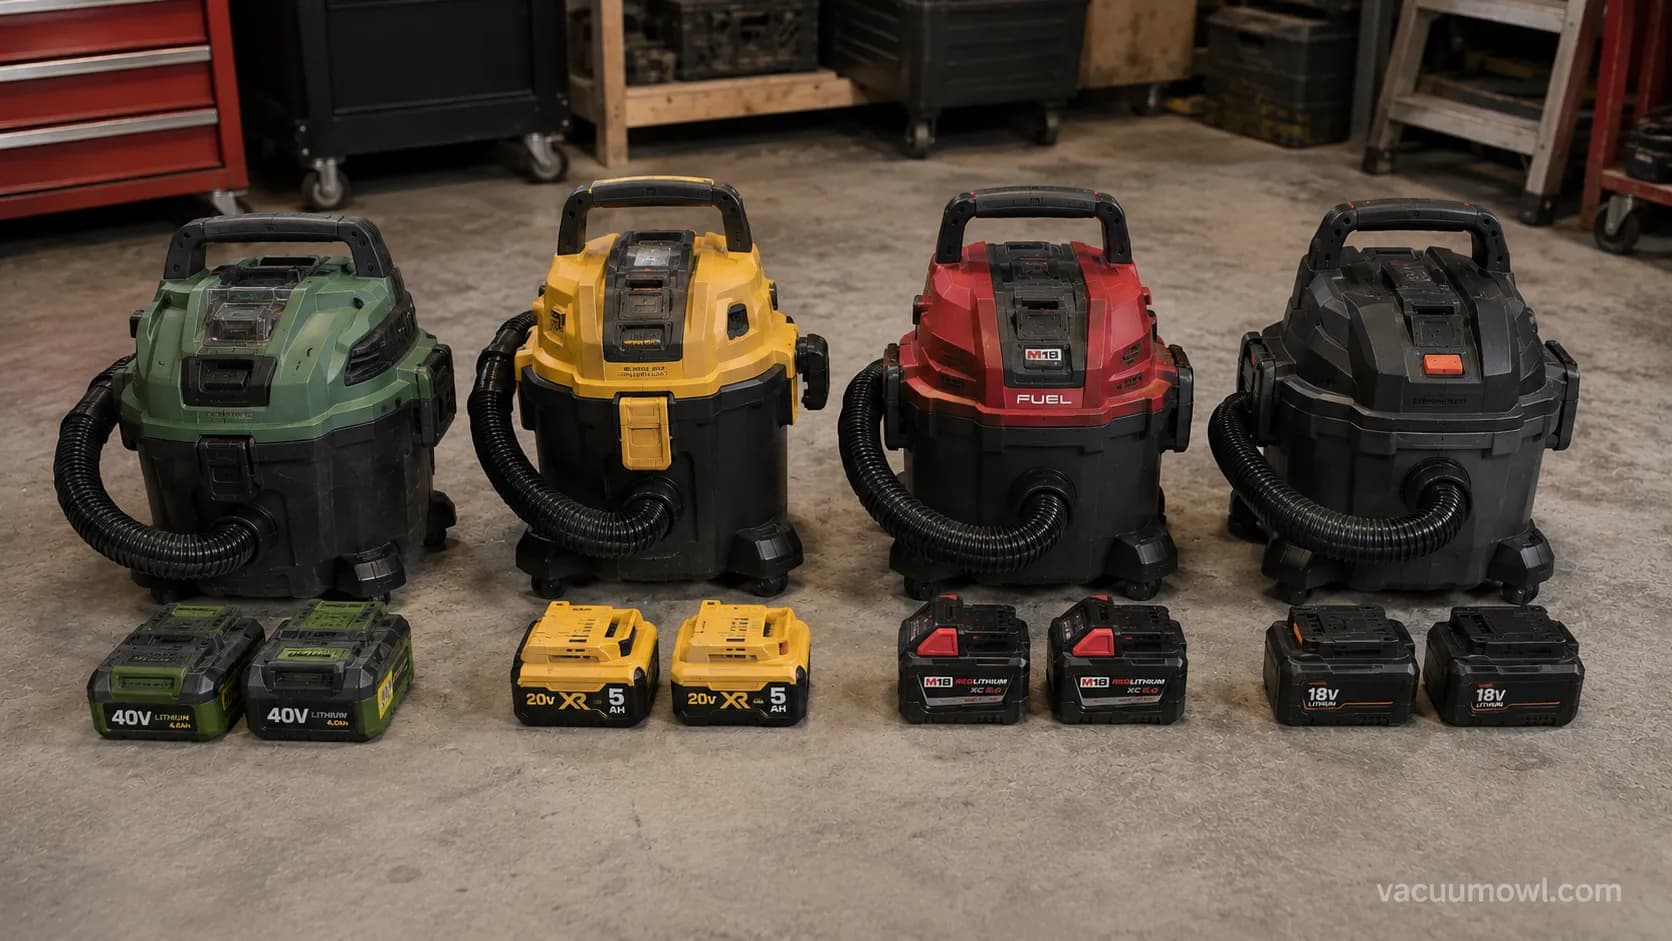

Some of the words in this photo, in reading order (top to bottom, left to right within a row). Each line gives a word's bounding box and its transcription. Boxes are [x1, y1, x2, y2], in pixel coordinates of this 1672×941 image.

[1027, 350, 1059, 359] M18
[1016, 394, 1073, 405] FUEL
[925, 677, 951, 686] M18
[1081, 678, 1108, 687] M18
[558, 691, 591, 711] XR
[608, 687, 625, 706] 5
[719, 691, 752, 710] XR
[770, 686, 787, 705] 5
[608, 705, 626, 714] AH
[770, 705, 787, 713] AH
[111, 709, 152, 726] 40V
[266, 707, 309, 724] 40V
